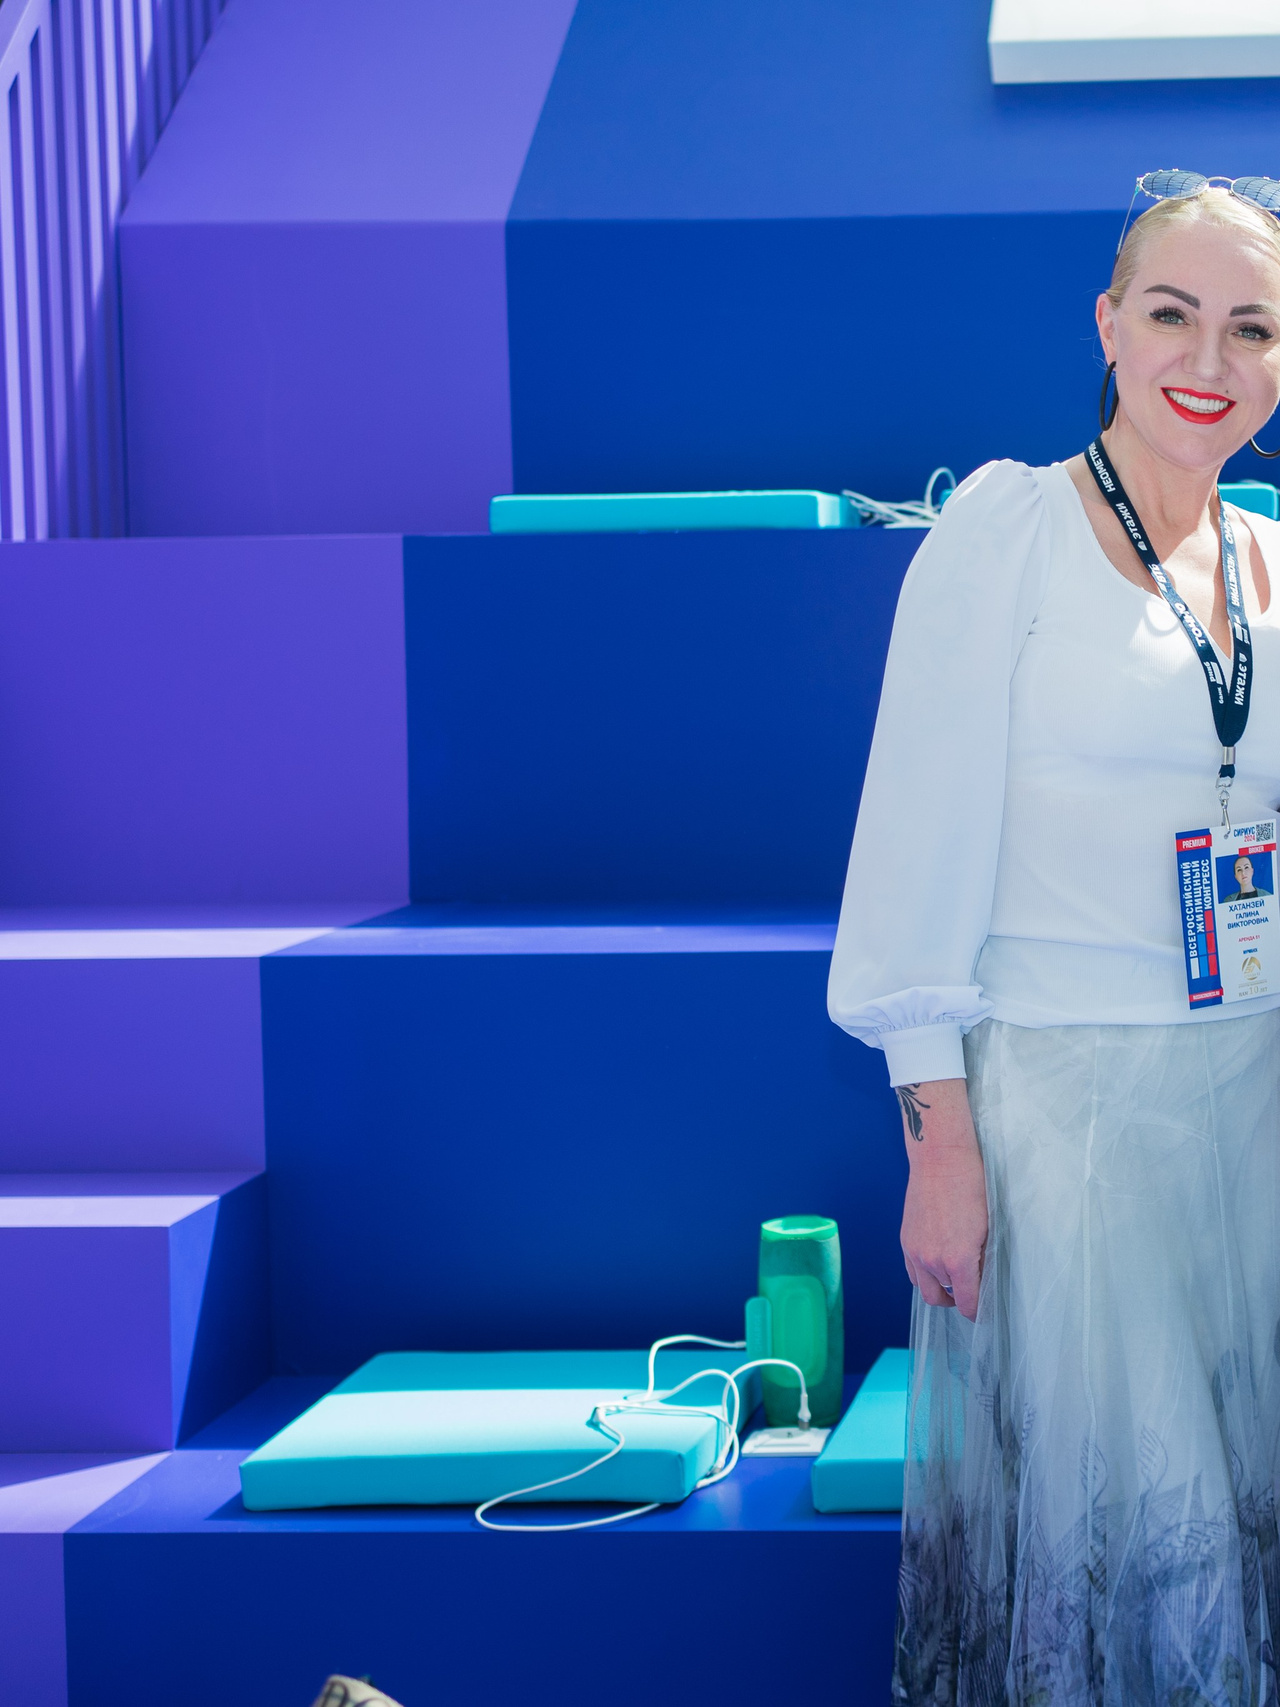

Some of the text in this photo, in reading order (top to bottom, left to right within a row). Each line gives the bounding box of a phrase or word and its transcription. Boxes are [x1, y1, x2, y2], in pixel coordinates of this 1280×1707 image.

[1227, 553, 1240, 607] НЕОМЕТРИЯ
[1233, 826, 1255, 838] СИРИУС
[1244, 834, 1255, 842] 2024
[1182, 838, 1207, 849] PREMIUM
[1201, 859, 1213, 910] КОНГРЕСС
[1189, 860, 1205, 933] ЖИЛИЩНЫЙ
[1180, 861, 1198, 957] ВСЕРОССИЙСКИЙ
[1228, 899, 1265, 913] ХАТАНЗЕЙ
[1235, 910, 1260, 920] ГАЛИНА
[1227, 917, 1269, 930] ВИКТОРОВНА
[1249, 986, 1259, 995] 10
